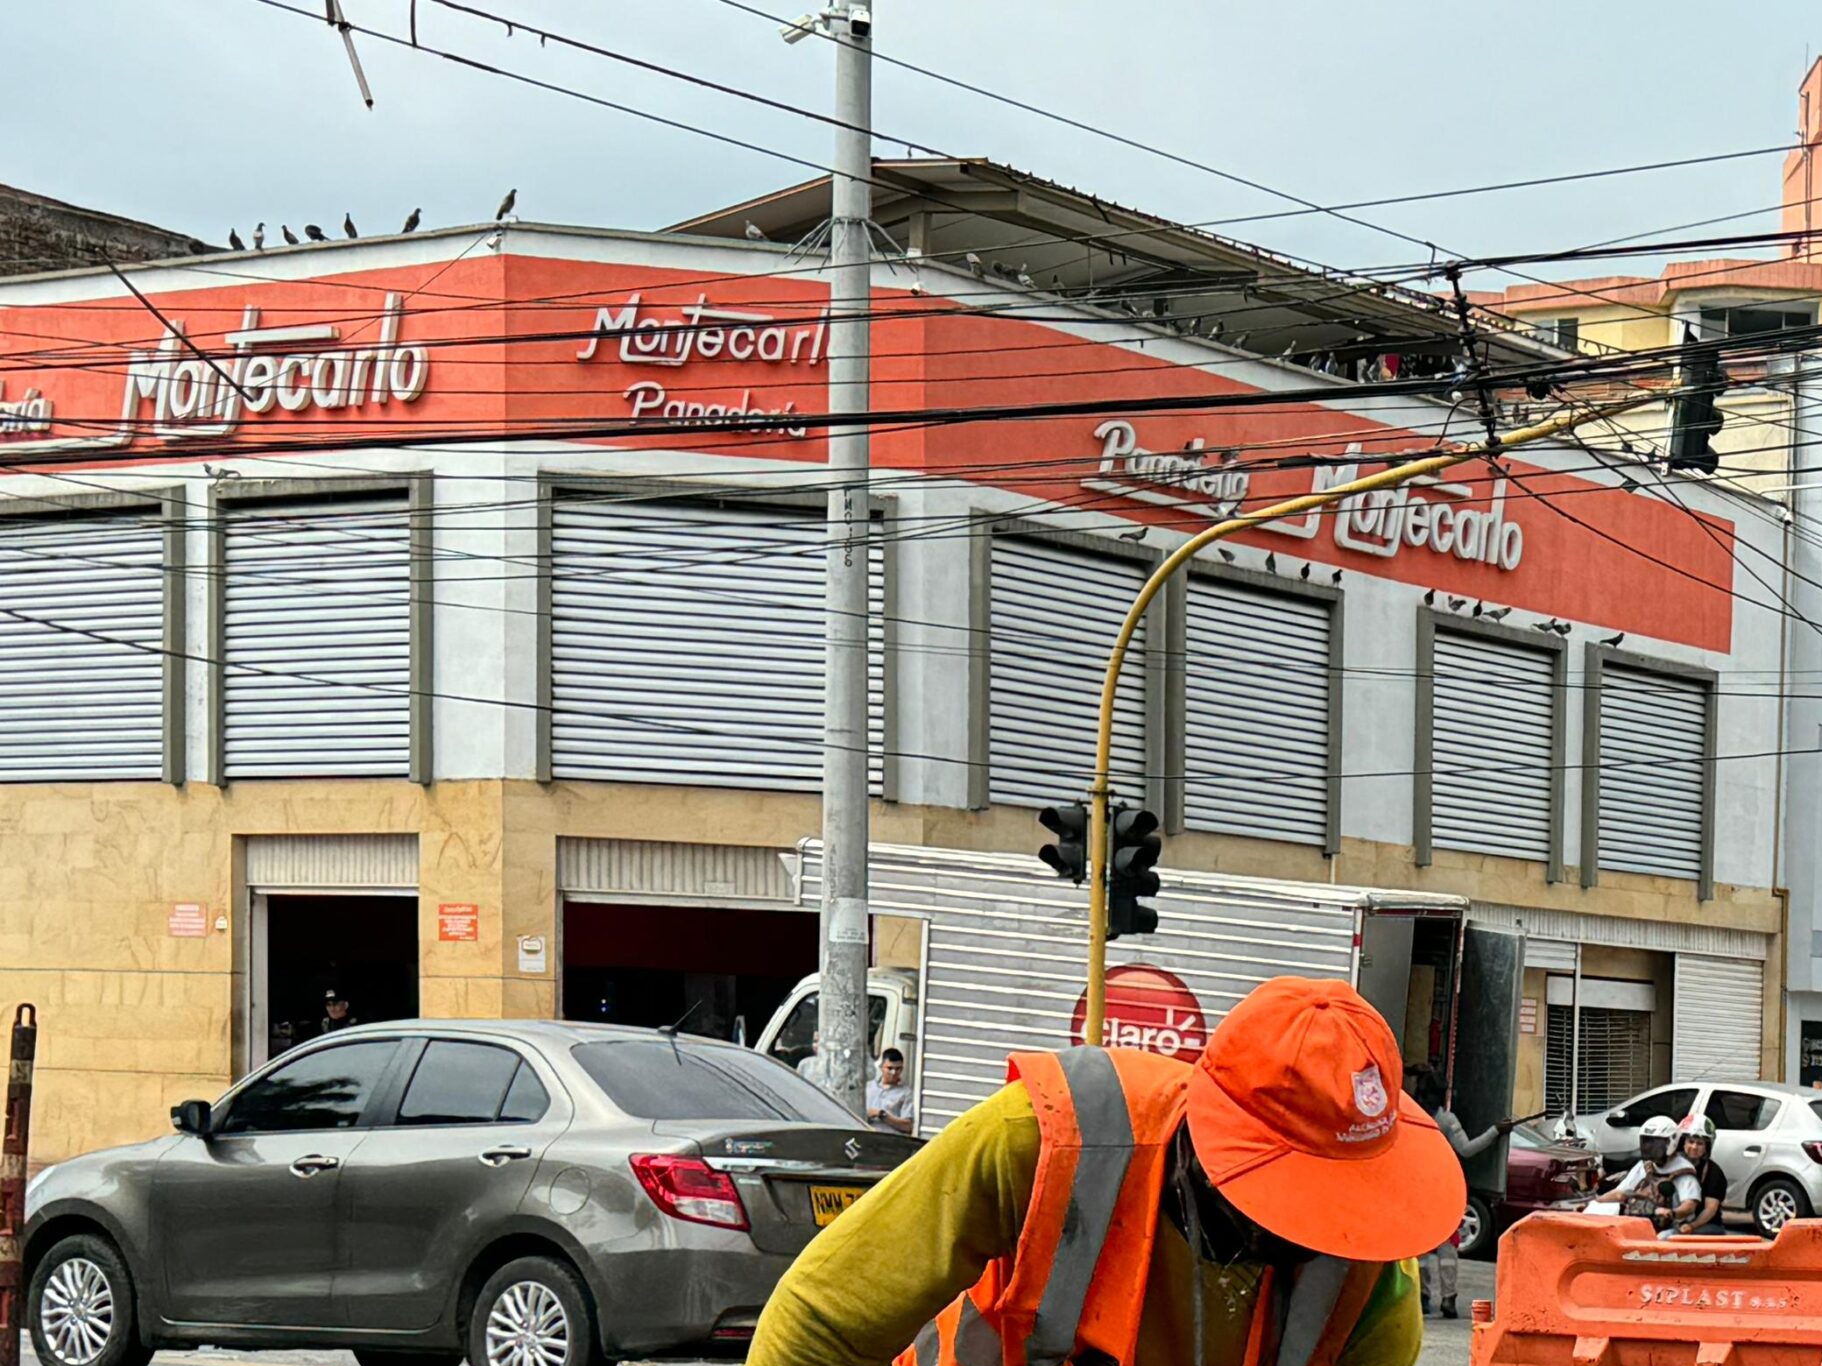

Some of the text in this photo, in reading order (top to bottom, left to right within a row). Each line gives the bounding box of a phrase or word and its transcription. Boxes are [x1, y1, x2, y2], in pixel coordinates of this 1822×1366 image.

[120, 292, 429, 443] Montecarlo
[576, 292, 830, 366] Montecarl
[1303, 442, 1524, 571] Montecarlo
[1639, 1283, 1747, 1310] SIPLAST
